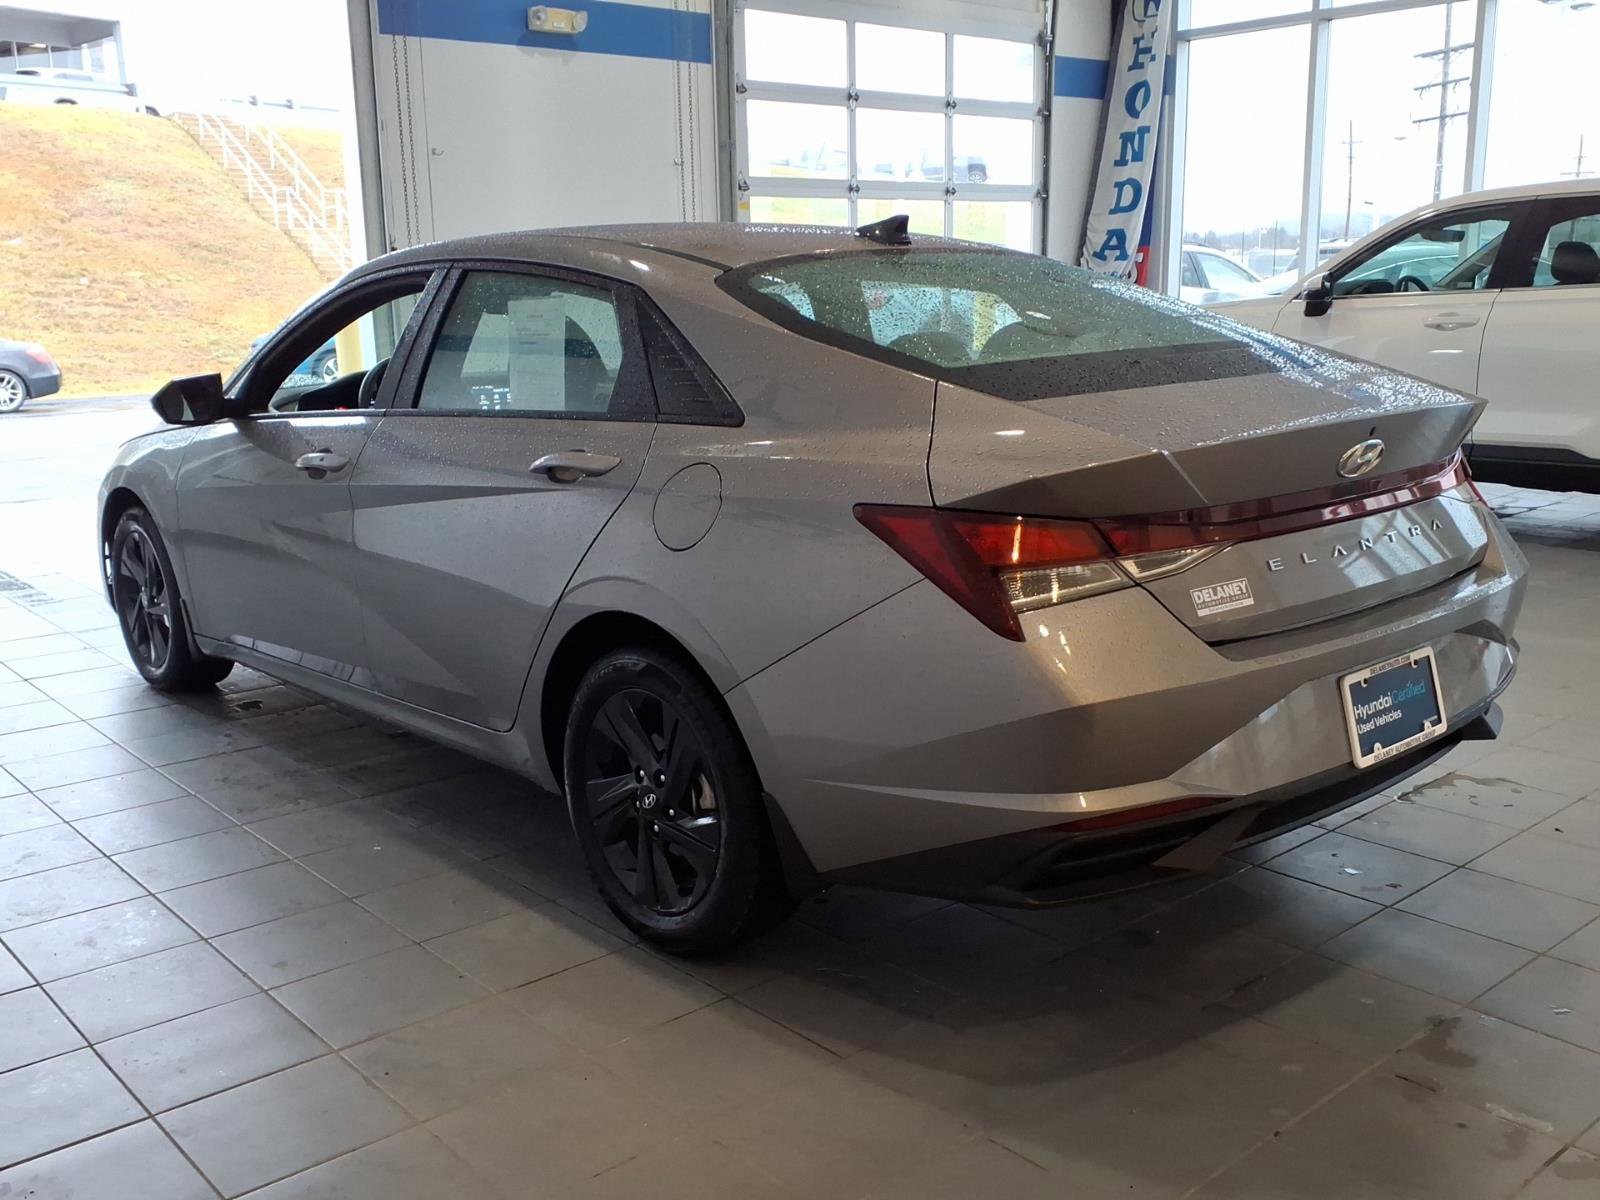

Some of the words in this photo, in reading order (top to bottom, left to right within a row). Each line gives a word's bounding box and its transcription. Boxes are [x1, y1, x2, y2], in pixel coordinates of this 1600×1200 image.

[1092, 25, 1158, 262] HONDA
[1267, 519, 1443, 572] ELANTRA
[1193, 580, 1248, 604] DELANEY
[1357, 718, 1375, 735] Used
[1374, 709, 1402, 727] Vehicles
